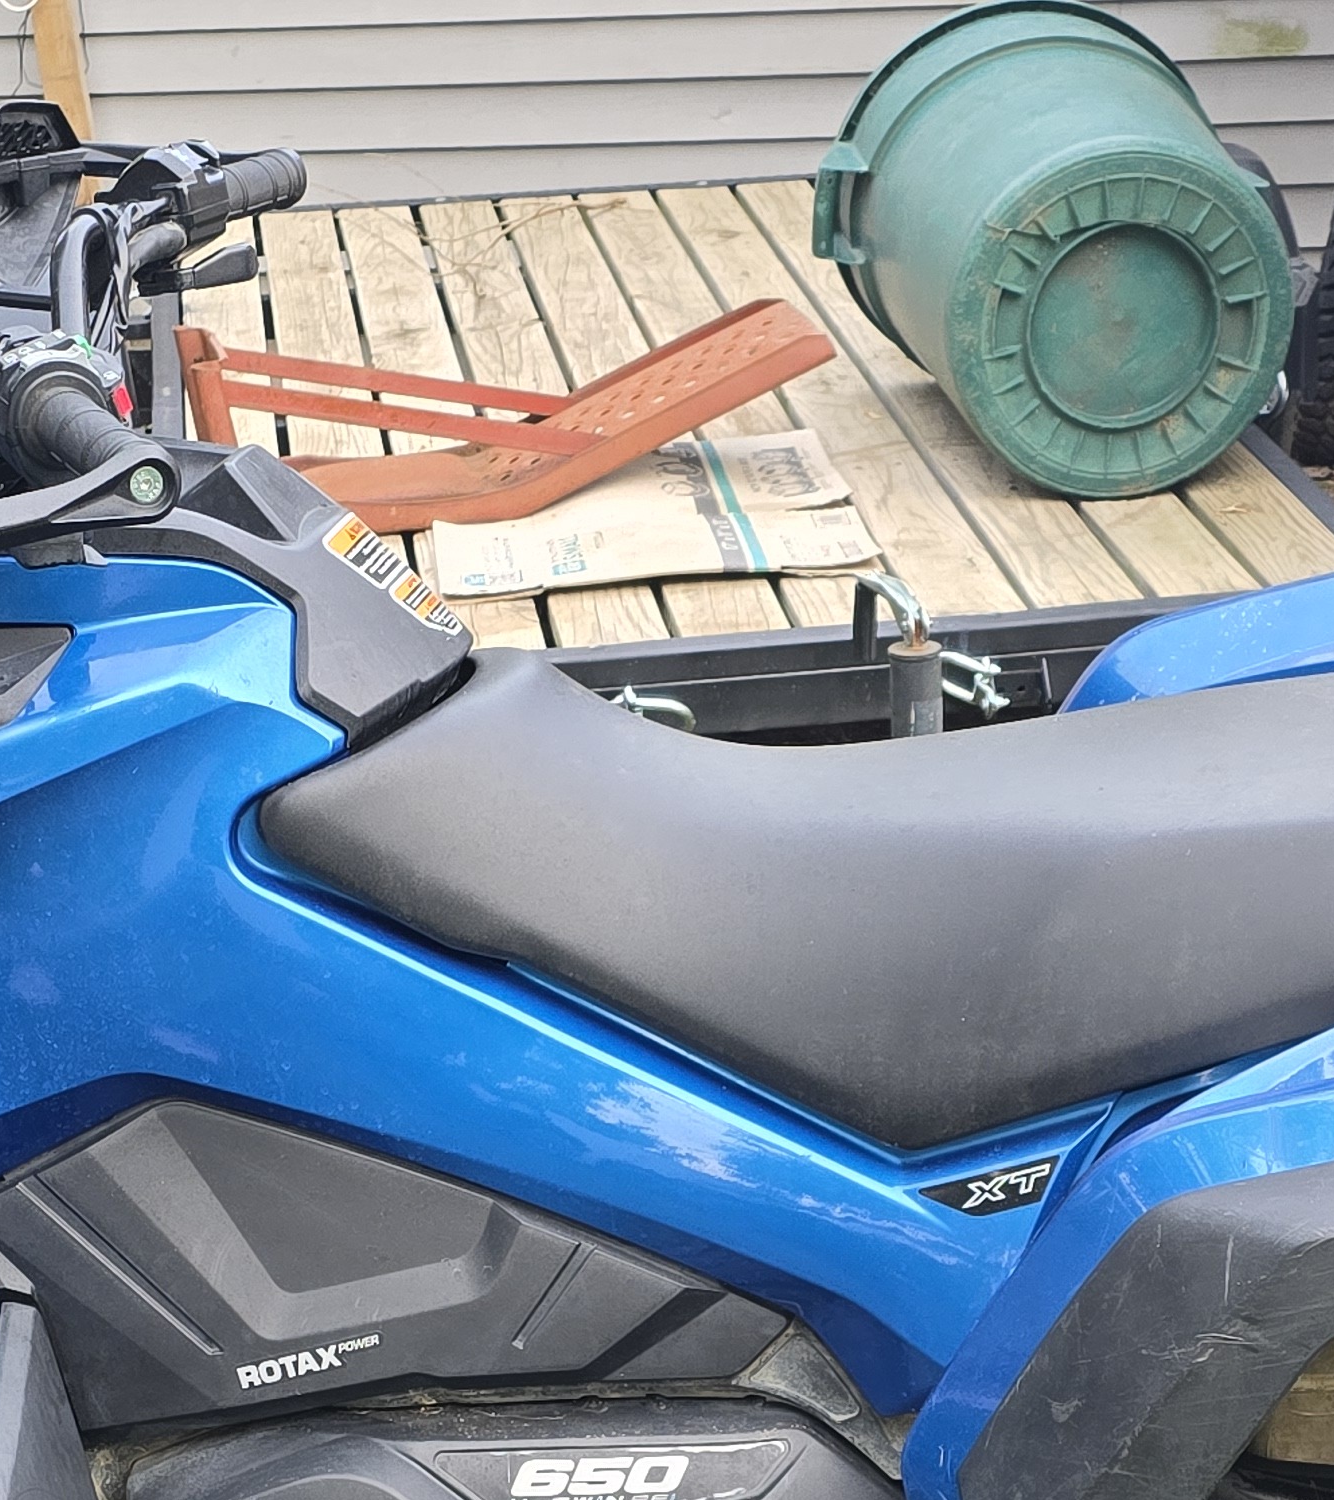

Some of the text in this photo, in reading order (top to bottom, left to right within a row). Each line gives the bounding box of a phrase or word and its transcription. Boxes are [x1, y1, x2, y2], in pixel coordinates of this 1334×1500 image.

[962, 1163, 1051, 1209] XT
[236, 1334, 380, 1389] ROTAX POWER
[510, 1455, 689, 1497] 650
